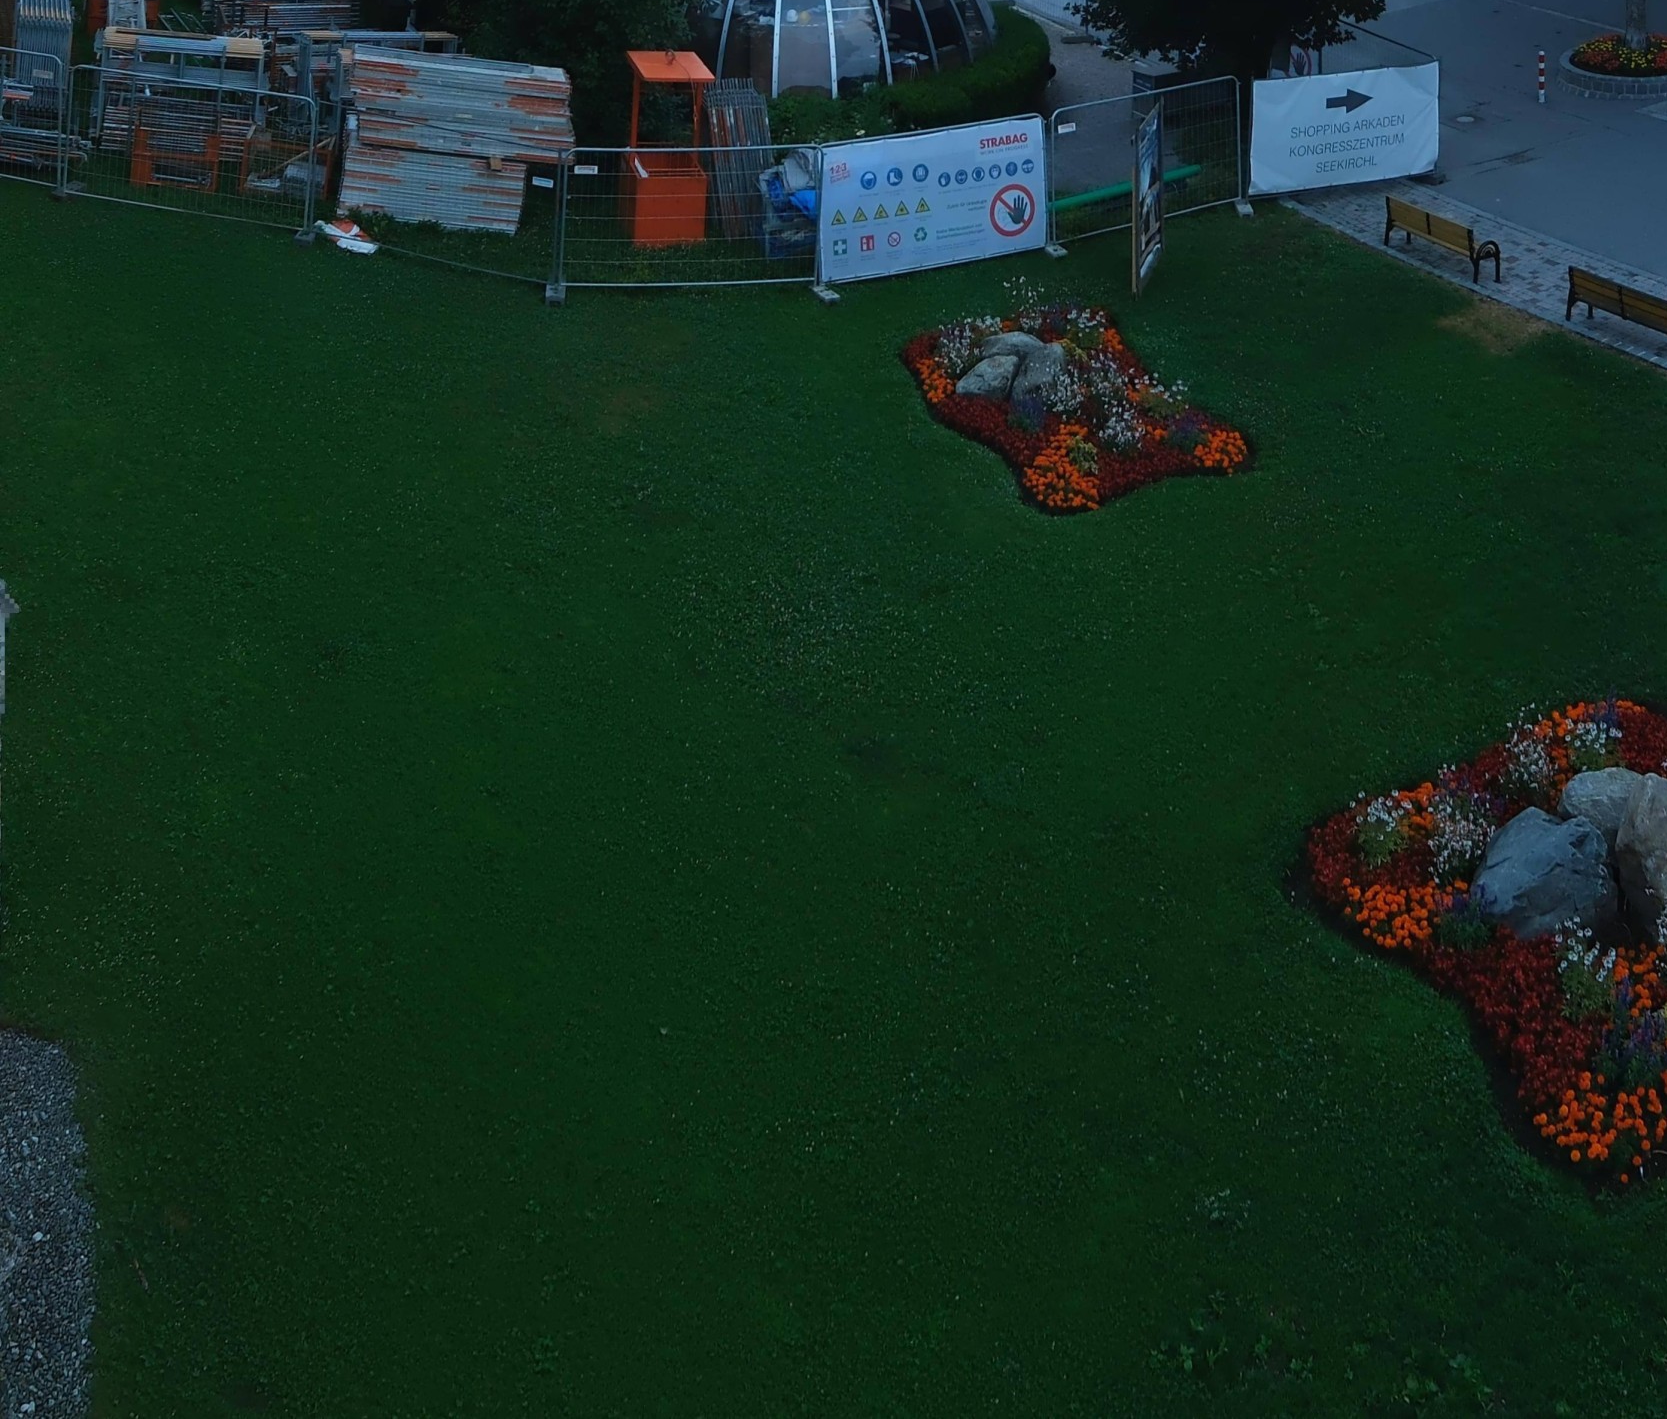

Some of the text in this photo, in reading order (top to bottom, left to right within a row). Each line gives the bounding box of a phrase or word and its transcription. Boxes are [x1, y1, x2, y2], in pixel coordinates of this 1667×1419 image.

[1290, 114, 1405, 139] SHOPPING ARKADEN
[979, 132, 1028, 149] STRABAG
[1289, 132, 1405, 158] KONGRESSZENTRUM
[1315, 156, 1377, 174] SEEKIRCHL
